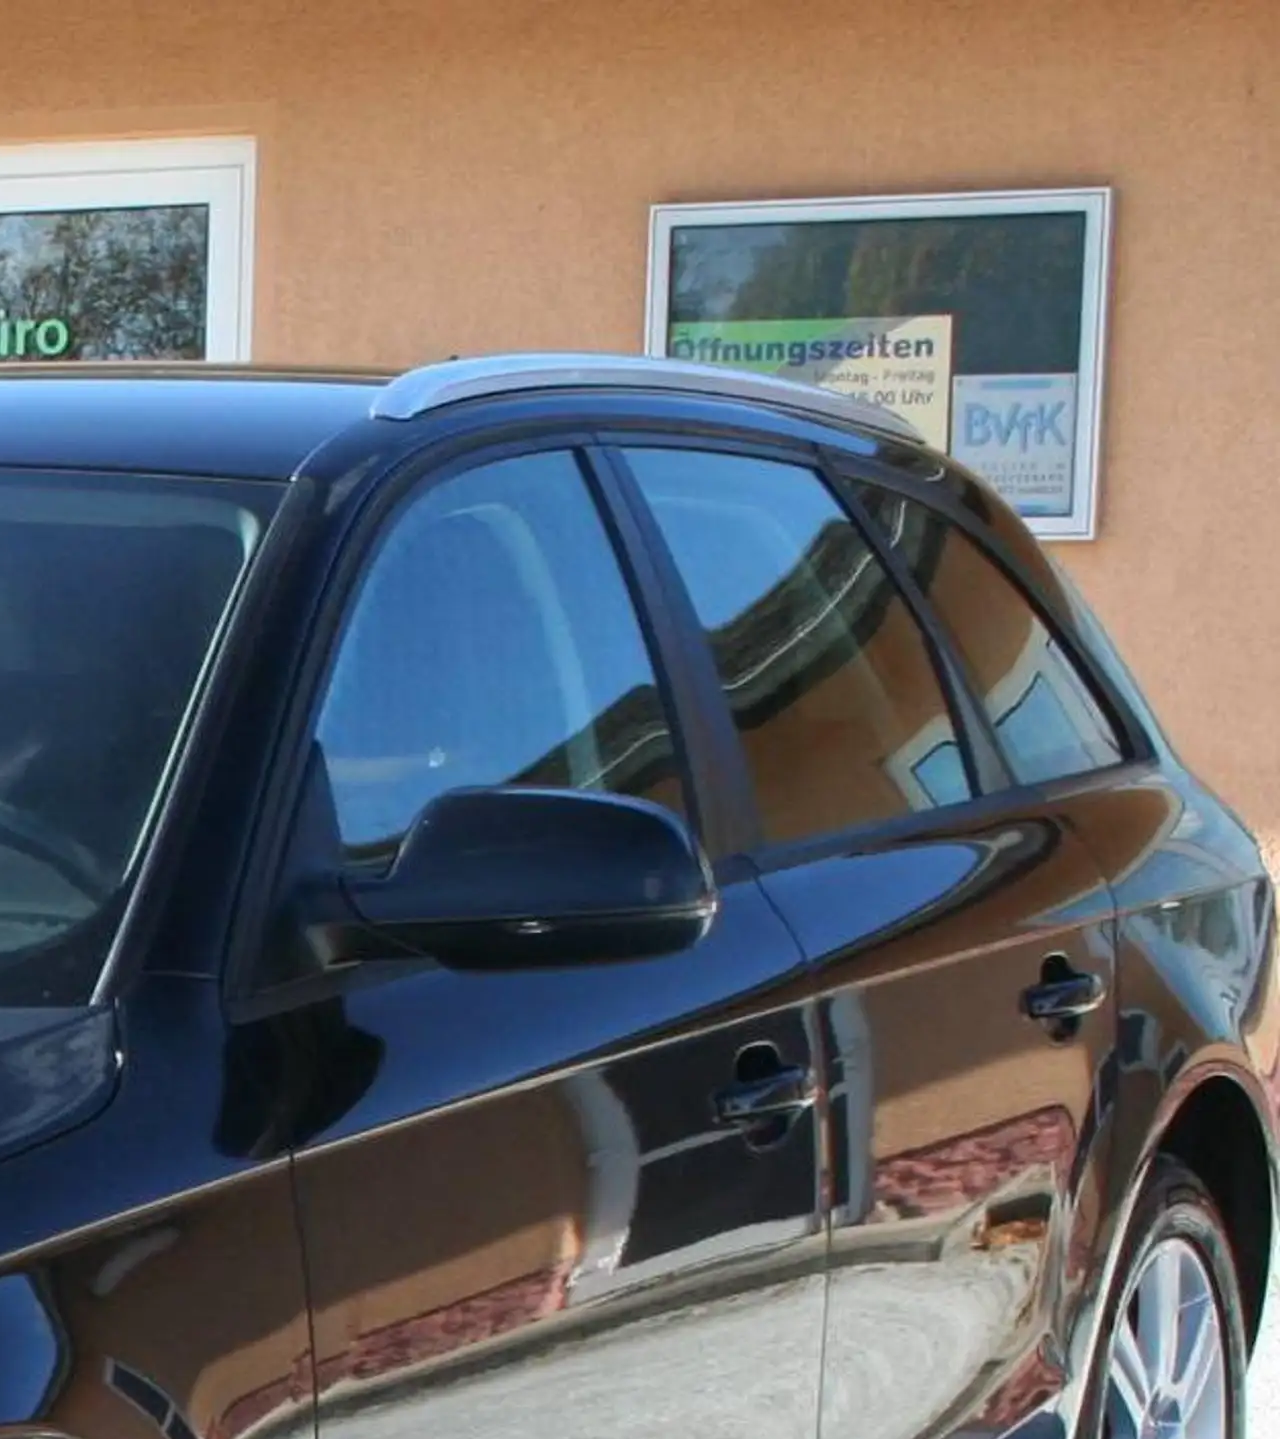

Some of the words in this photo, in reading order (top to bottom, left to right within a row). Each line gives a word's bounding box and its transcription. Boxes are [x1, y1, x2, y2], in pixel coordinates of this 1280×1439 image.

[673, 327, 934, 366] Öffnungszeiten
[883, 368, 935, 384] Freitag
[902, 389, 934, 405] Uhr
[964, 401, 1066, 453] BVfK
